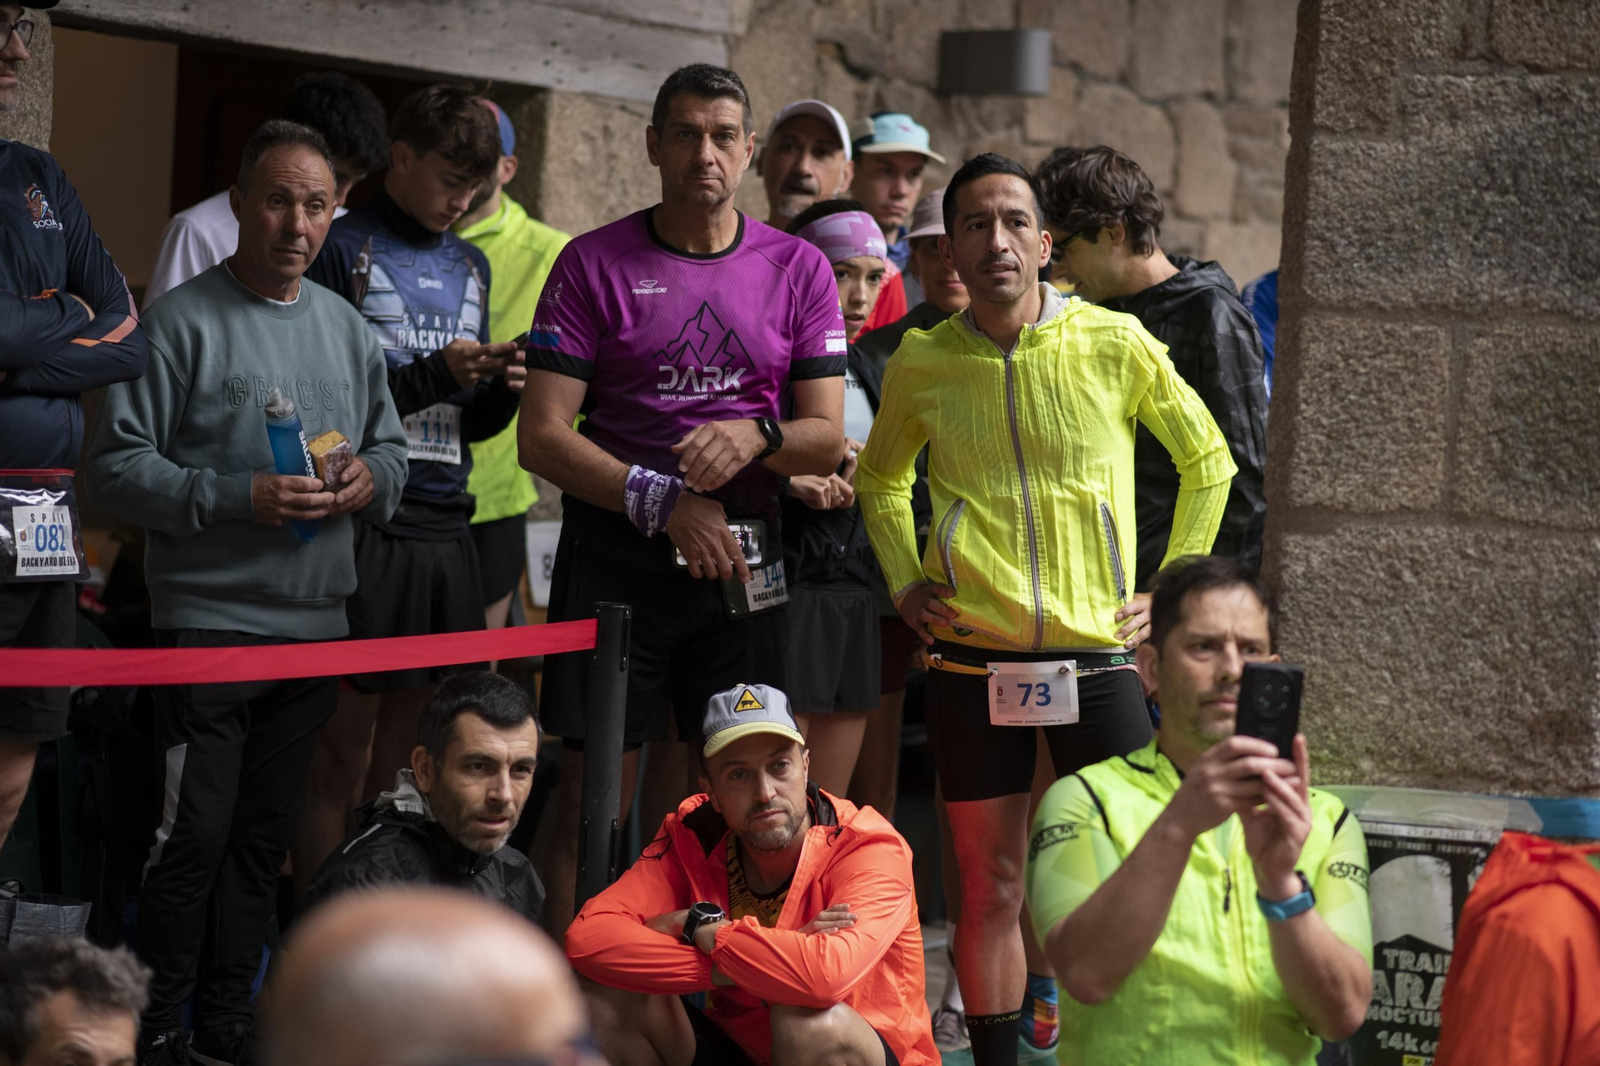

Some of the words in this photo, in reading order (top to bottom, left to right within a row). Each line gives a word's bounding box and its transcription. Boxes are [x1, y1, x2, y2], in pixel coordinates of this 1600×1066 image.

[657, 365, 747, 393] DARK
[678, 394, 708, 402] RUNNING
[420, 421, 451, 446] 111
[299, 430, 317, 480] SALOM
[35, 524, 67, 552] 082
[21, 556, 58, 568] BACKYARD
[1016, 682, 1052, 707] 73
